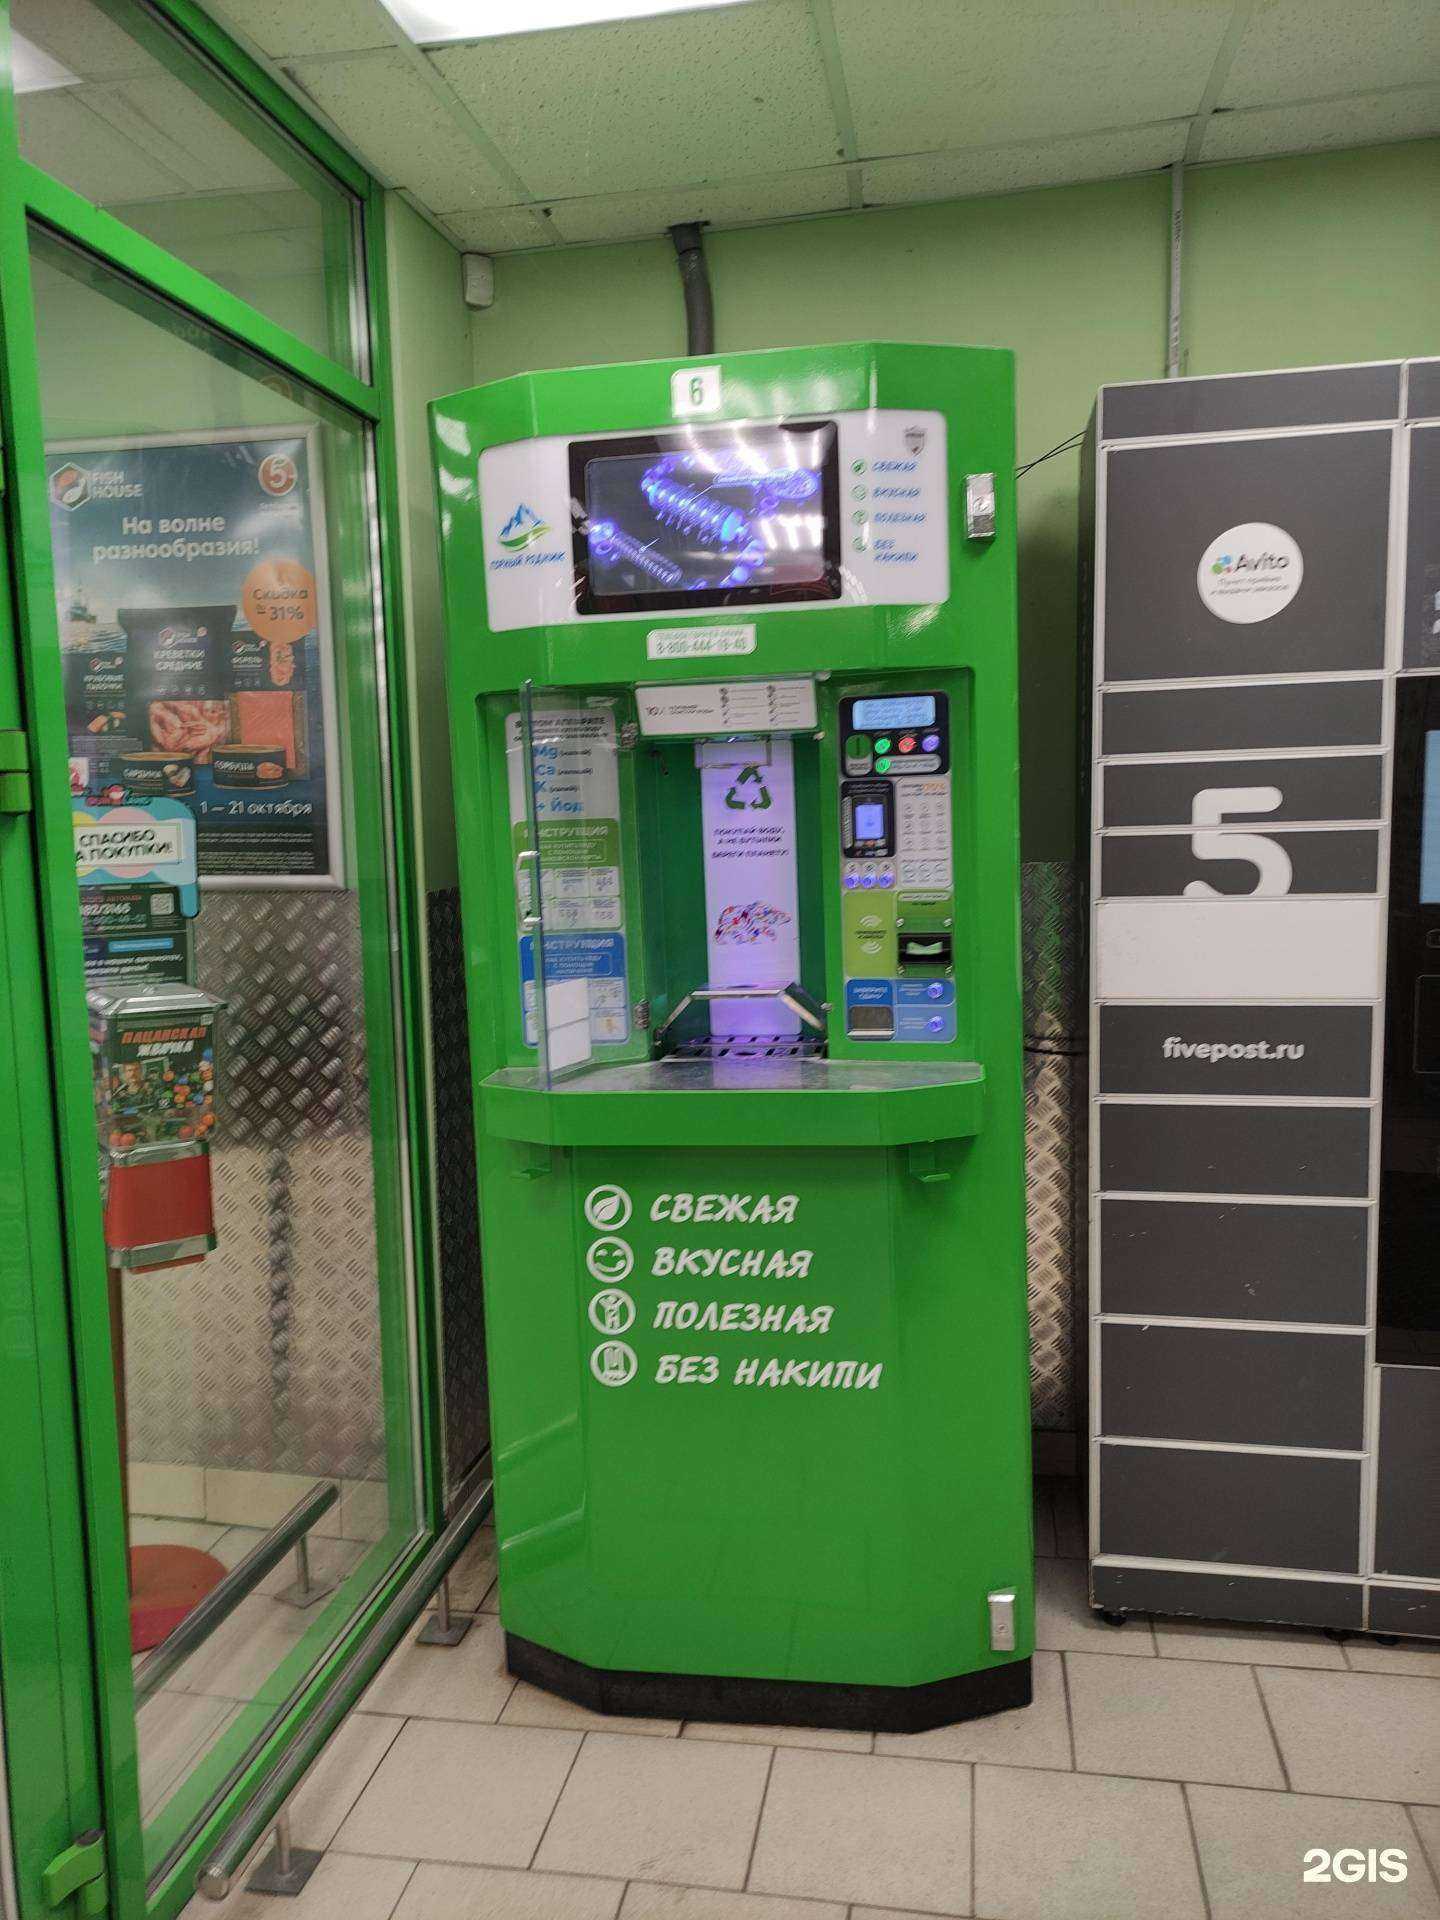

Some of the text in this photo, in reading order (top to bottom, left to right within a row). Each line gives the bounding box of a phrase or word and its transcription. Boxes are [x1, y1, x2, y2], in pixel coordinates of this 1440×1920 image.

[690, 377, 704, 406] 6
[873, 460, 918, 472] СВЕЖАЯ
[93, 483, 144, 498] HOUSE
[873, 486, 921, 498] ВКУСНАЯ
[122, 516, 225, 535] На волне
[874, 512, 927, 523] ПОЛЕЗНАЯ
[92, 538, 260, 564] разнообразия!
[1234, 552, 1290, 572] Avito
[252, 587, 309, 600] Скидка
[269, 605, 305, 620] 31%
[200, 801, 208, 815] 1
[228, 801, 245, 815] 21
[246, 799, 313, 818] октября
[80, 828, 155, 848] СПАСИБО
[1183, 785, 1294, 896] 5
[1161, 1036, 1306, 1063] fivepost.ru
[650, 1193, 800, 1225] СВЕЖАЯ
[651, 1246, 814, 1280] ВКУСНАЯ
[652, 1300, 835, 1335] ПОЛЕЗНАЯ
[654, 1353, 884, 1390] БЕЗ НАКИПИ
